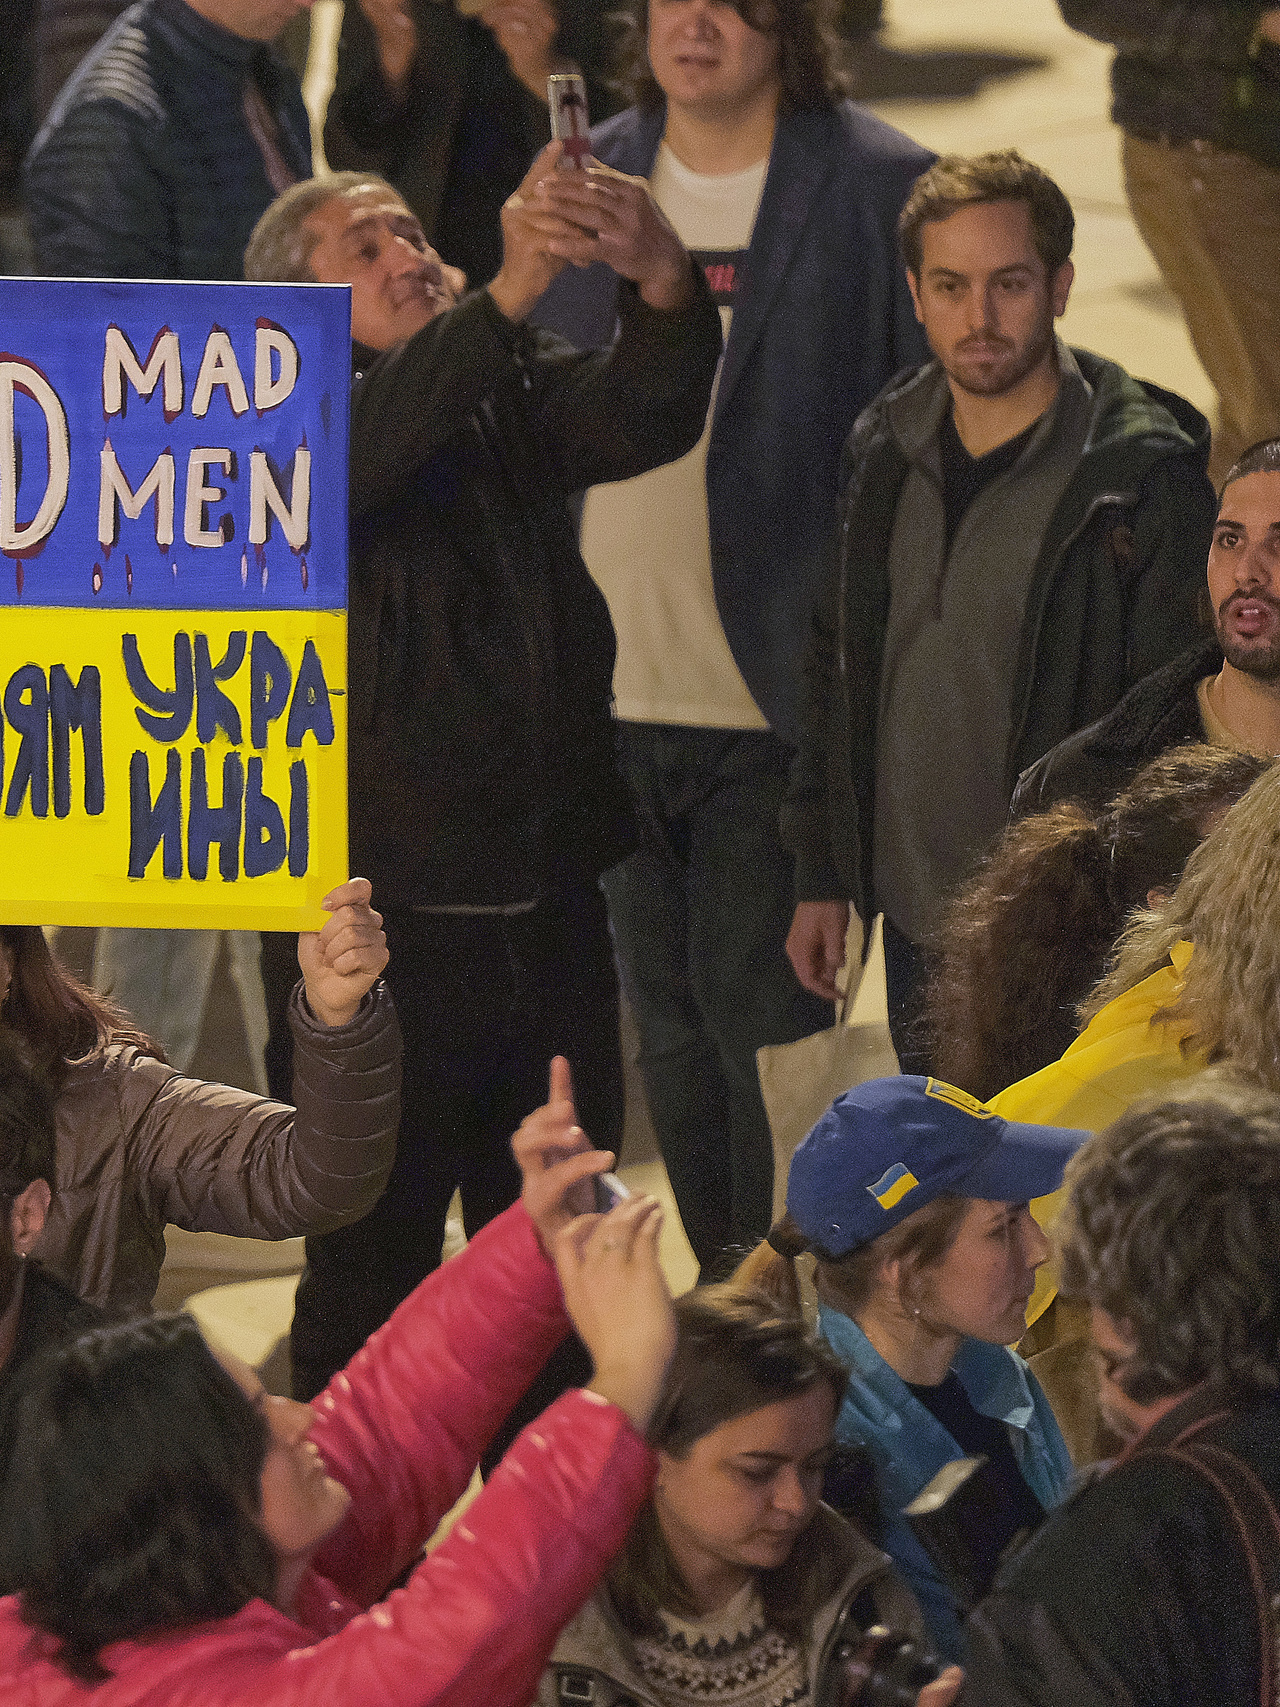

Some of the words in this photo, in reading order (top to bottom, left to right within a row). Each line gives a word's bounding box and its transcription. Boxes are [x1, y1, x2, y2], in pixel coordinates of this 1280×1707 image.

[102, 318, 300, 424] MAD
[100, 438, 314, 548] MEN
[126, 750, 312, 882] ИНЫ
